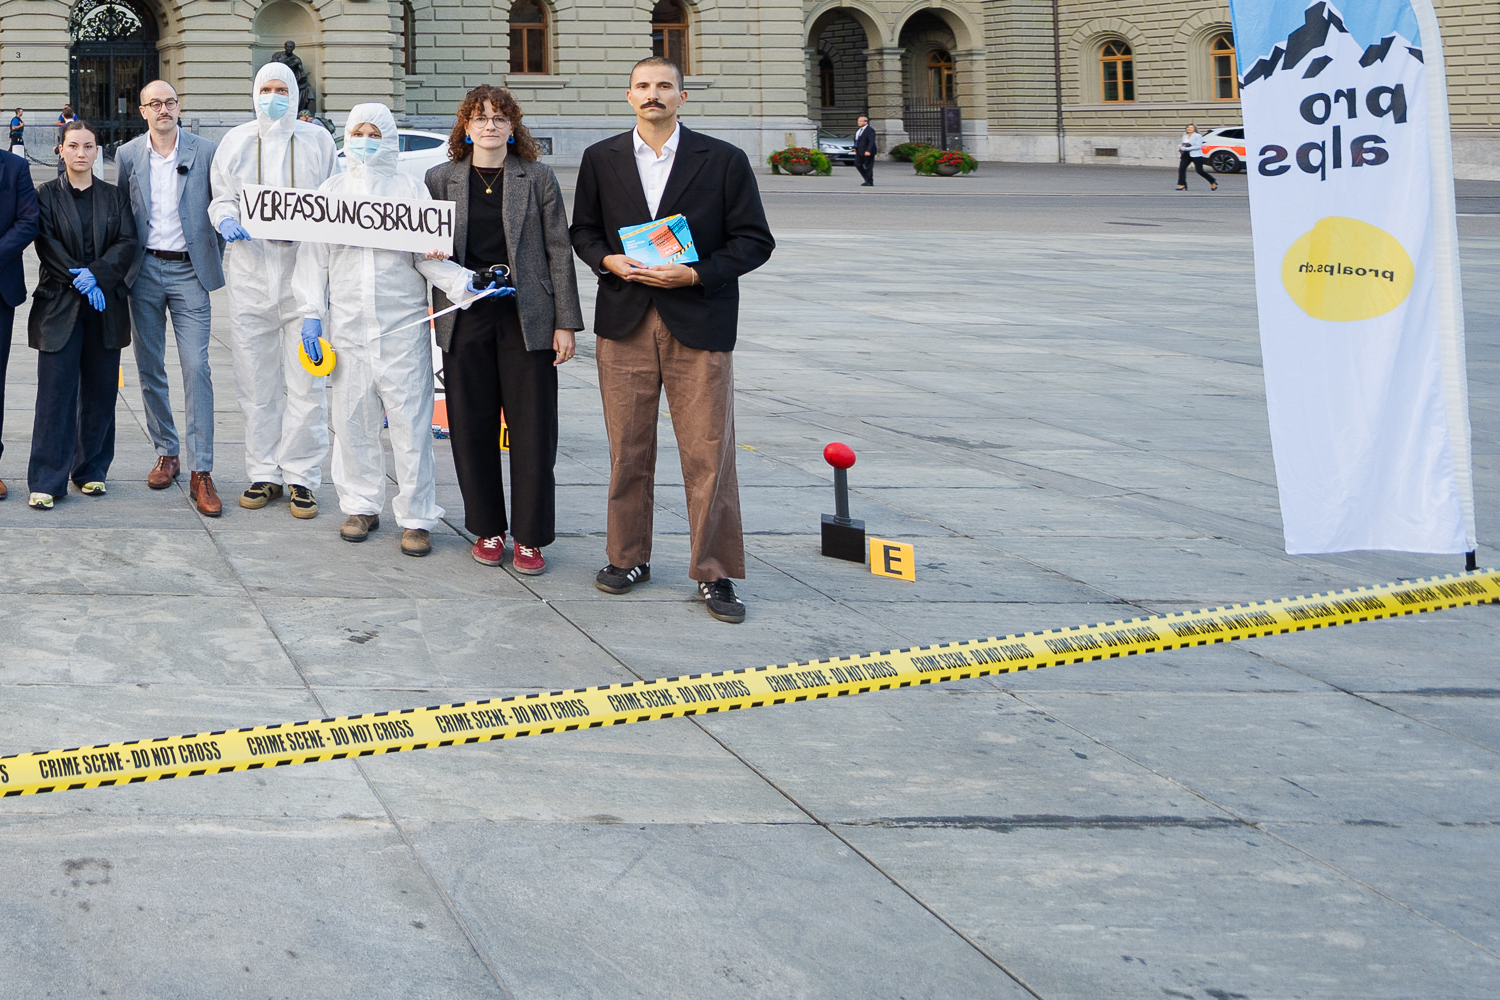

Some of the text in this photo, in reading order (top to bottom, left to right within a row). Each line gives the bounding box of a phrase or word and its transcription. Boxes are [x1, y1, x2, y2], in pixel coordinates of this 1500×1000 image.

[244, 189, 453, 238] VERFASSUNGSBRUCH
[883, 544, 903, 576] E
[1044, 637, 1077, 655] CRIME
[1070, 634, 1102, 652] SCENE
[1100, 632, 1118, 647] DO
[1113, 630, 1134, 646] NOT
[1129, 626, 1161, 643] CROSS
[910, 654, 945, 673] CRIME
[939, 651, 972, 670] SCENE
[970, 650, 988, 665] DO
[984, 647, 1005, 664] NOT
[1000, 643, 1035, 661] CROSS
[765, 673, 801, 693] CRIME
[795, 670, 830, 689] SCENE
[829, 667, 847, 684] DO
[843, 665, 868, 683] NOT
[862, 661, 898, 680] CROSS
[607, 691, 644, 712] CRIME
[640, 688, 677, 709] SCENE
[677, 686, 696, 704] DO
[691, 683, 717, 702] NOT
[714, 680, 751, 699] CROSS
[435, 712, 474, 733] CRIME
[470, 708, 509, 729] SCENE
[511, 705, 530, 724] DO
[526, 702, 553, 722] NOT
[550, 699, 590, 719] CROSS
[246, 732, 288, 756] CRIME
[286, 730, 326, 751] SCENE
[330, 727, 349, 746] DO
[347, 724, 374, 744] NOT
[373, 720, 414, 740] CROSS
[39, 756, 82, 779] CRIME
[84, 752, 124, 775] SCENE
[131, 749, 151, 769] DO
[152, 745, 177, 767] NOT
[178, 741, 222, 763] CROSS
